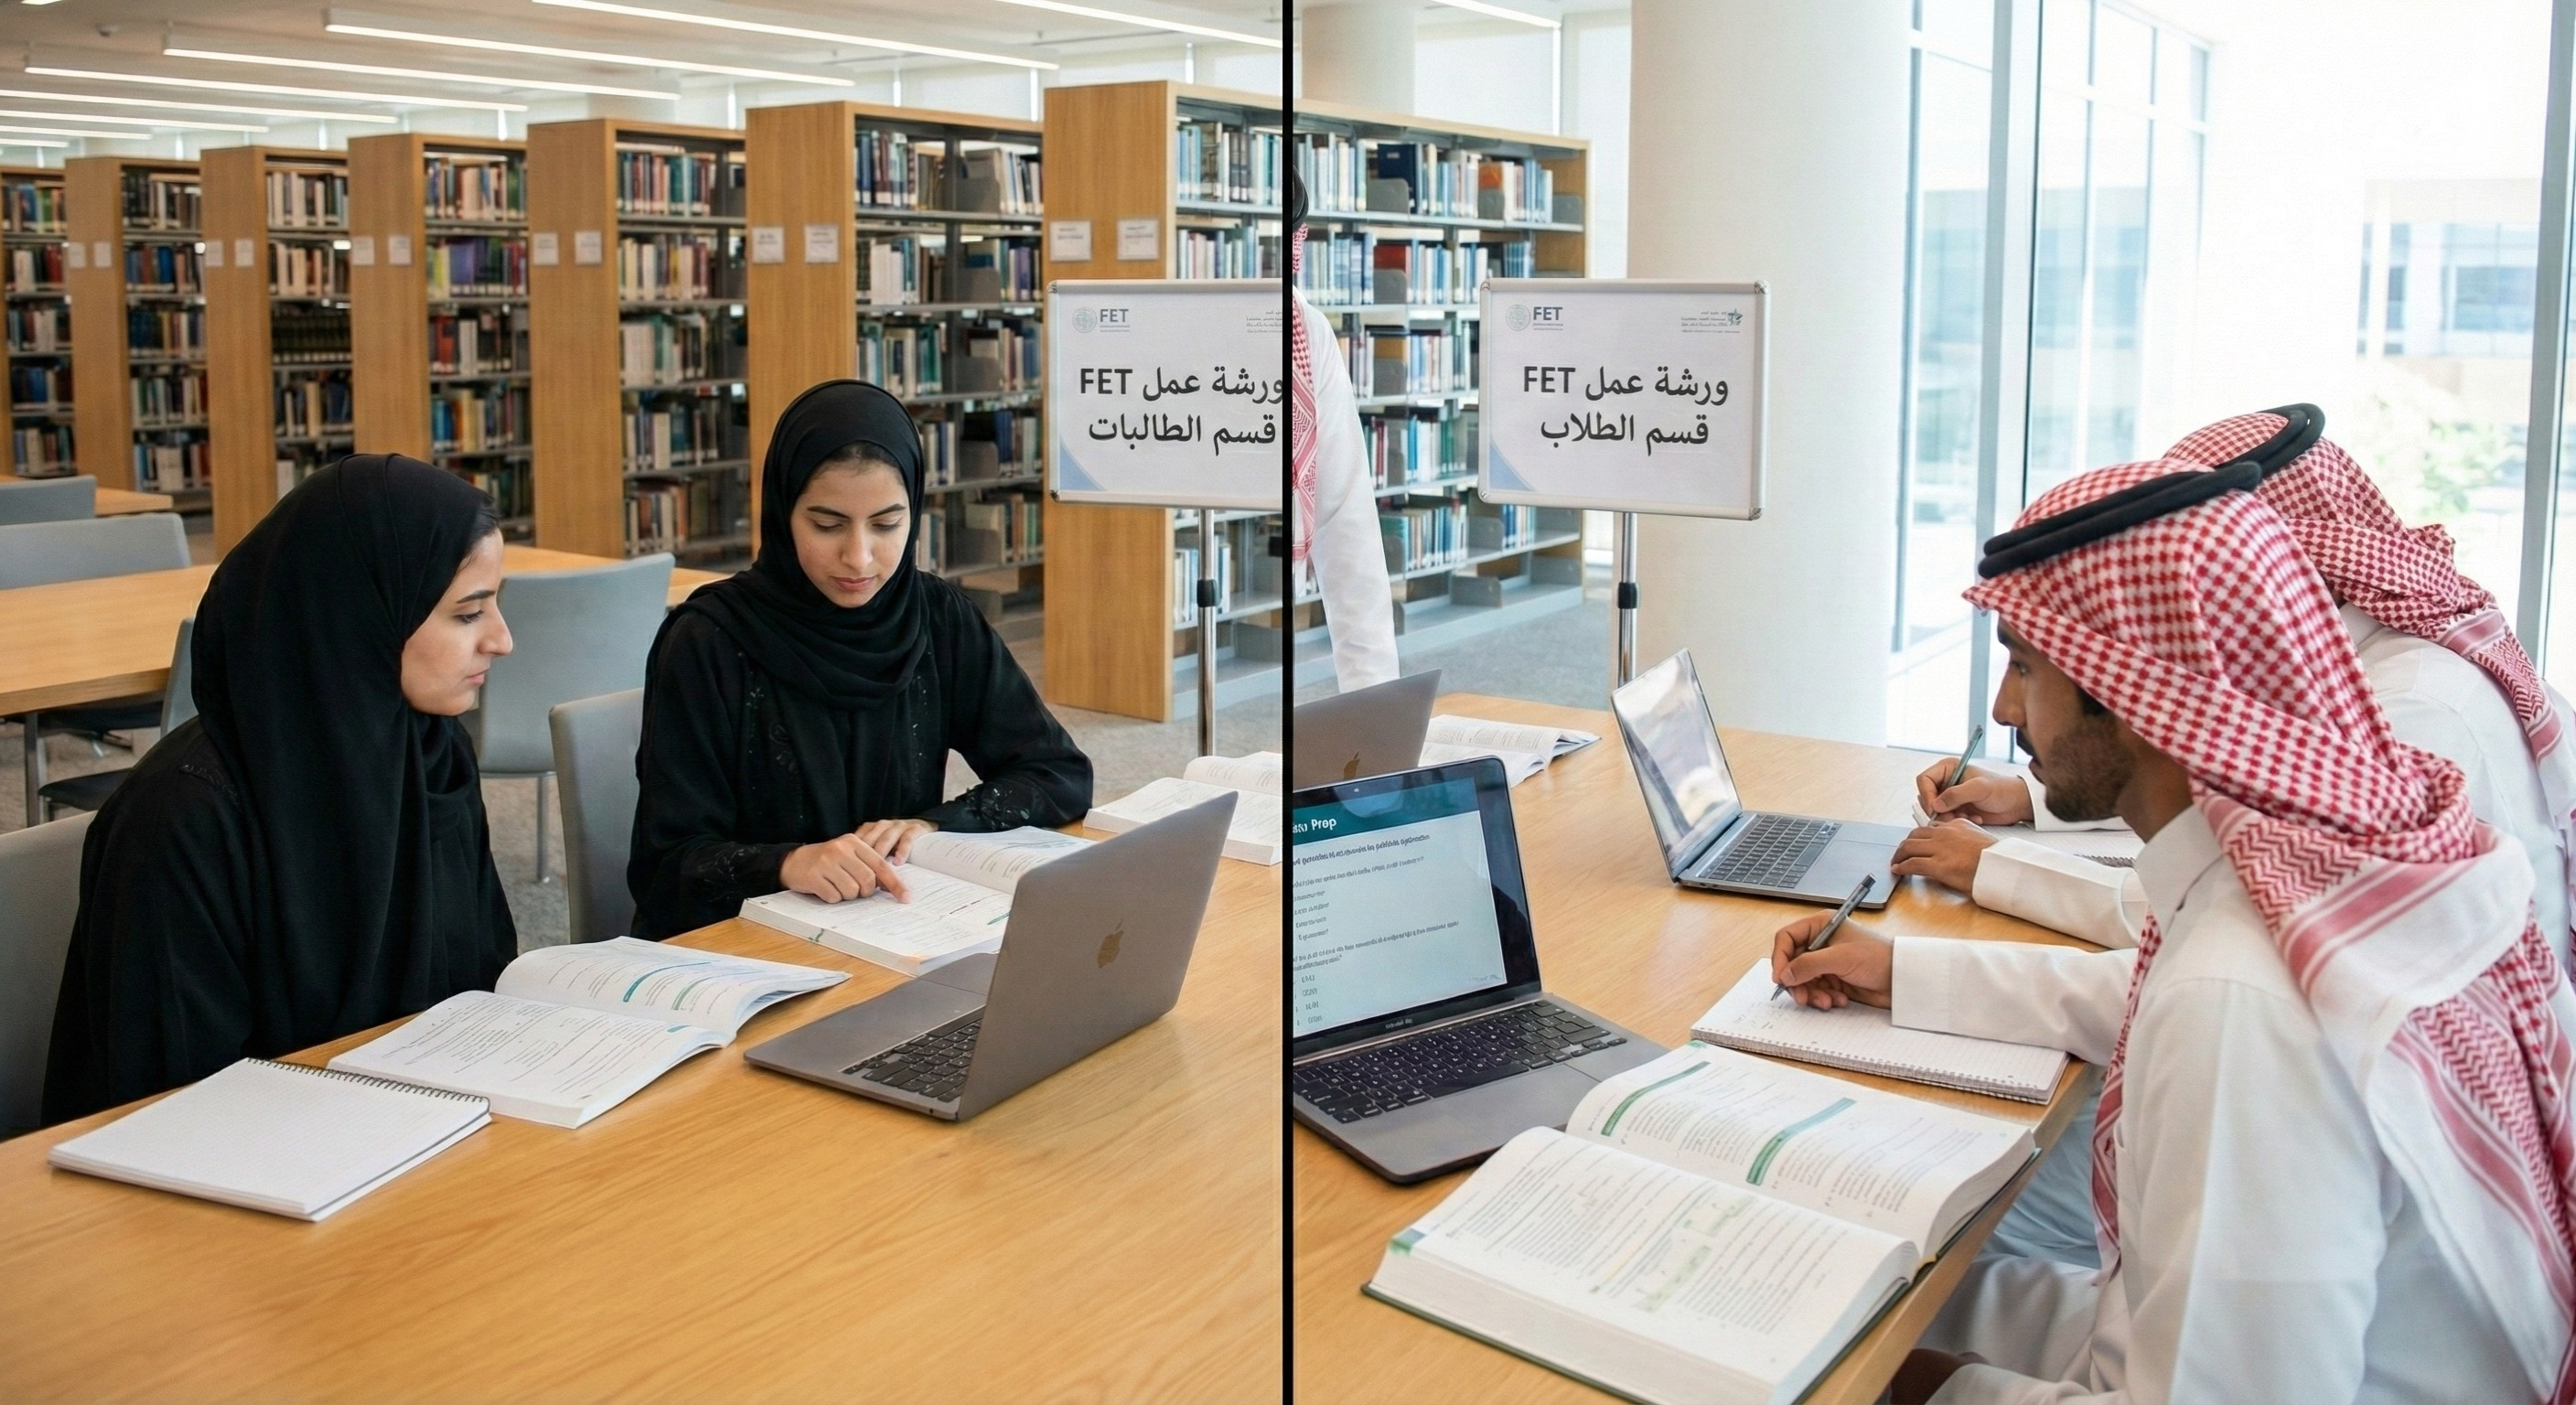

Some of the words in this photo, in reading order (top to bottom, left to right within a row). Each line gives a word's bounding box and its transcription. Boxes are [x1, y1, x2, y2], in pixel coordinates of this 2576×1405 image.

[1100, 308, 1130, 323] FET
[1532, 306, 1563, 321] FET
[1080, 368, 1133, 395] FET
[1143, 366, 1201, 402] عمل
[1523, 366, 1576, 393] FET
[1585, 366, 1644, 402] عمل
[1654, 366, 1729, 406] ورشة
[1089, 413, 1202, 450] الطالبات
[1213, 413, 1276, 456] قسم
[1540, 412, 1635, 448] الطلاب
[1646, 413, 1709, 456] قسم
[1311, 818, 1337, 831] Prep
